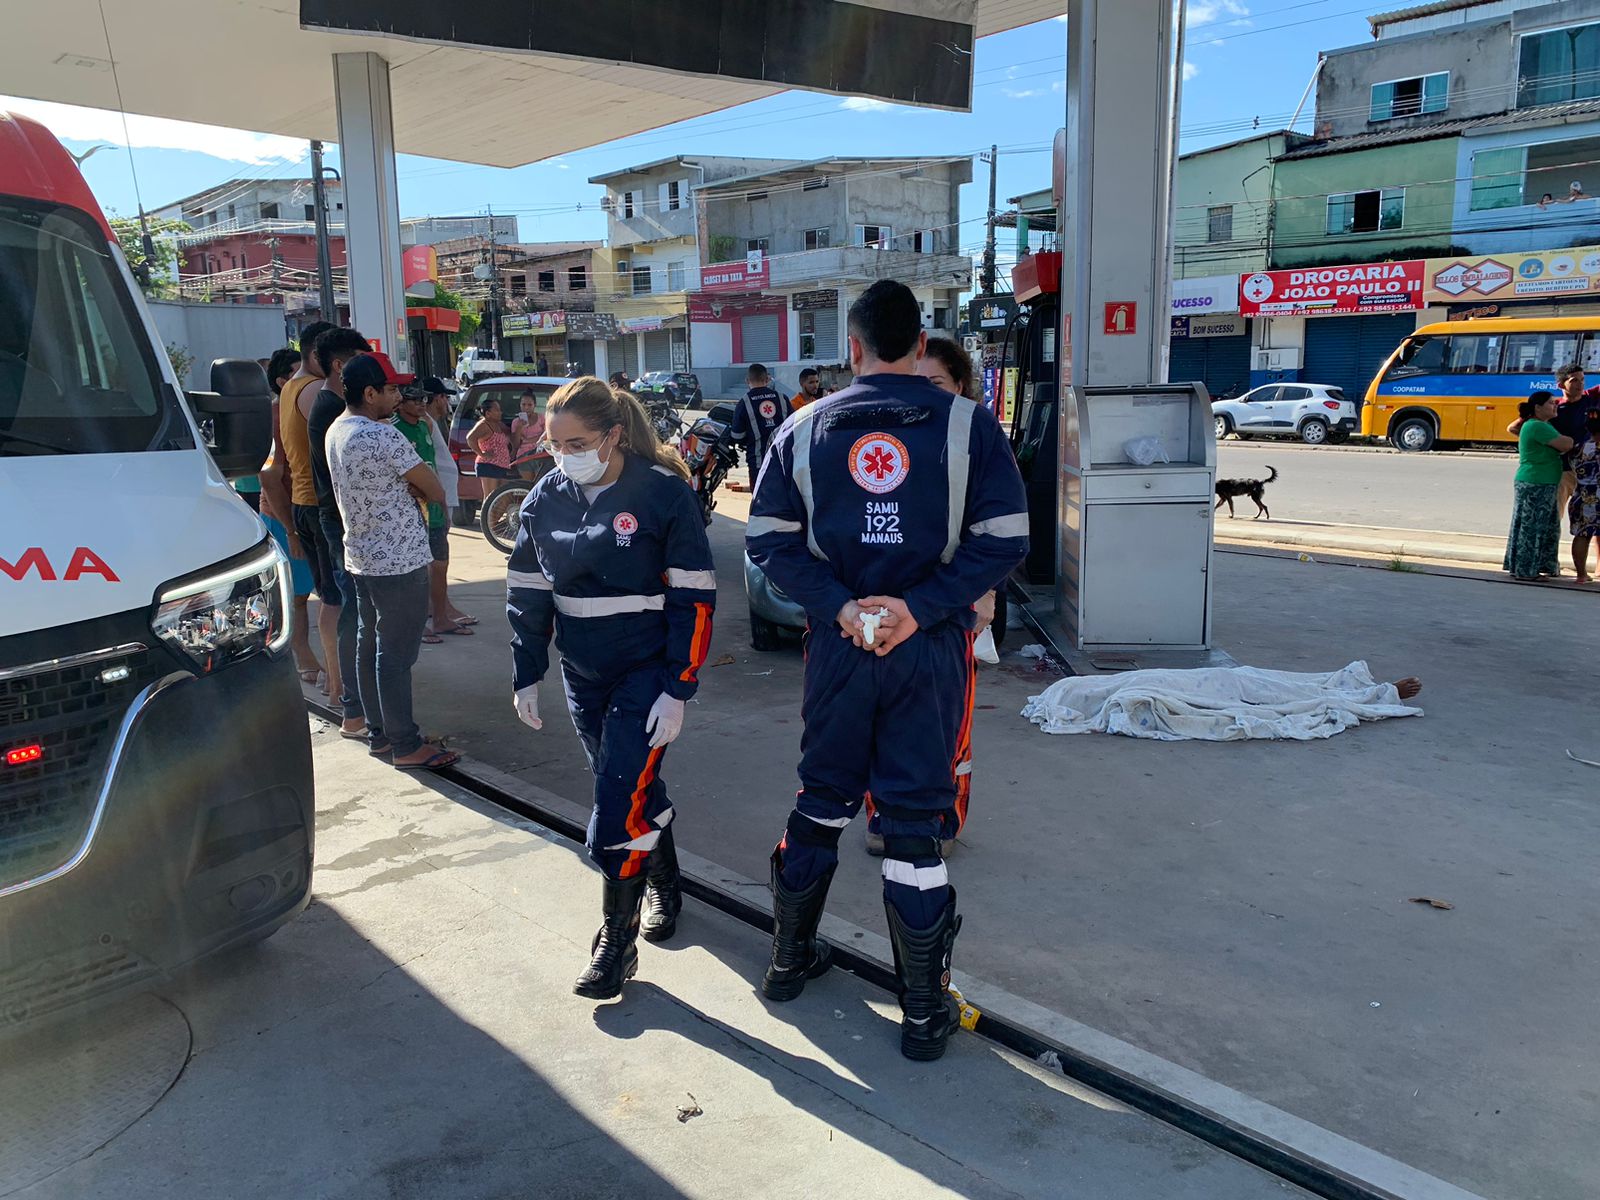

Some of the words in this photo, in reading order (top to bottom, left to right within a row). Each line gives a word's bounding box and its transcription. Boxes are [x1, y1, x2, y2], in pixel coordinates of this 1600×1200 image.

[1290, 265, 1406, 285] DROGARIA
[1279, 284, 1330, 299] JOÃO
[1336, 281, 1400, 296] PAULO
[1407, 279, 1421, 291] II
[1171, 297, 1213, 308] UCESSO
[1192, 326, 1206, 334] BOM
[1207, 324, 1235, 334] SUCESSO
[866, 501, 899, 514] SAMU
[864, 515, 900, 532] 192
[616, 539, 631, 547] 192
[861, 532, 904, 544] MANAUS
